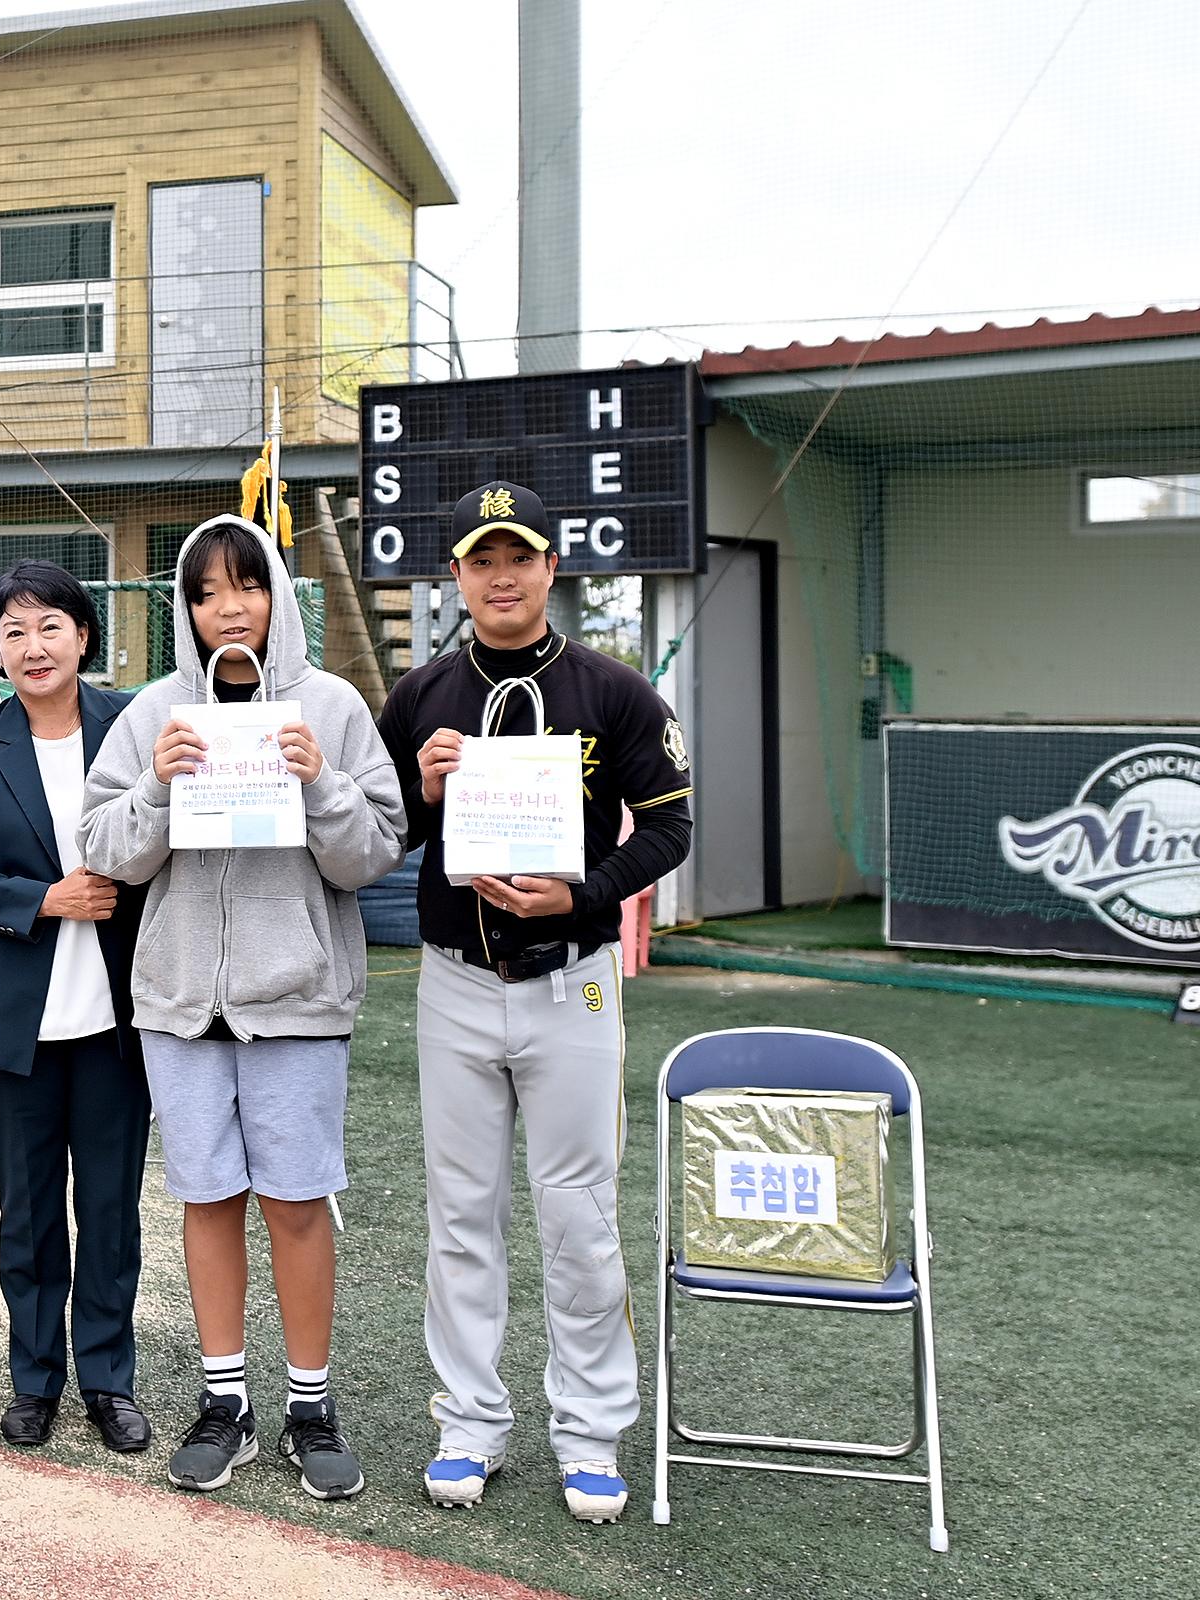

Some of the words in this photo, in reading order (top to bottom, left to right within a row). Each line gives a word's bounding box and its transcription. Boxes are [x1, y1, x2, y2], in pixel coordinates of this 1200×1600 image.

[374, 404, 403, 442] B
[589, 387, 622, 429] H
[374, 465, 402, 504] S
[592, 452, 622, 493] E
[373, 525, 404, 563] O
[560, 517, 624, 557] FC
[457, 790, 564, 810] 축하드립니다.
[583, 982, 603, 1012] 9
[730, 1161, 821, 1215] 추첨함
